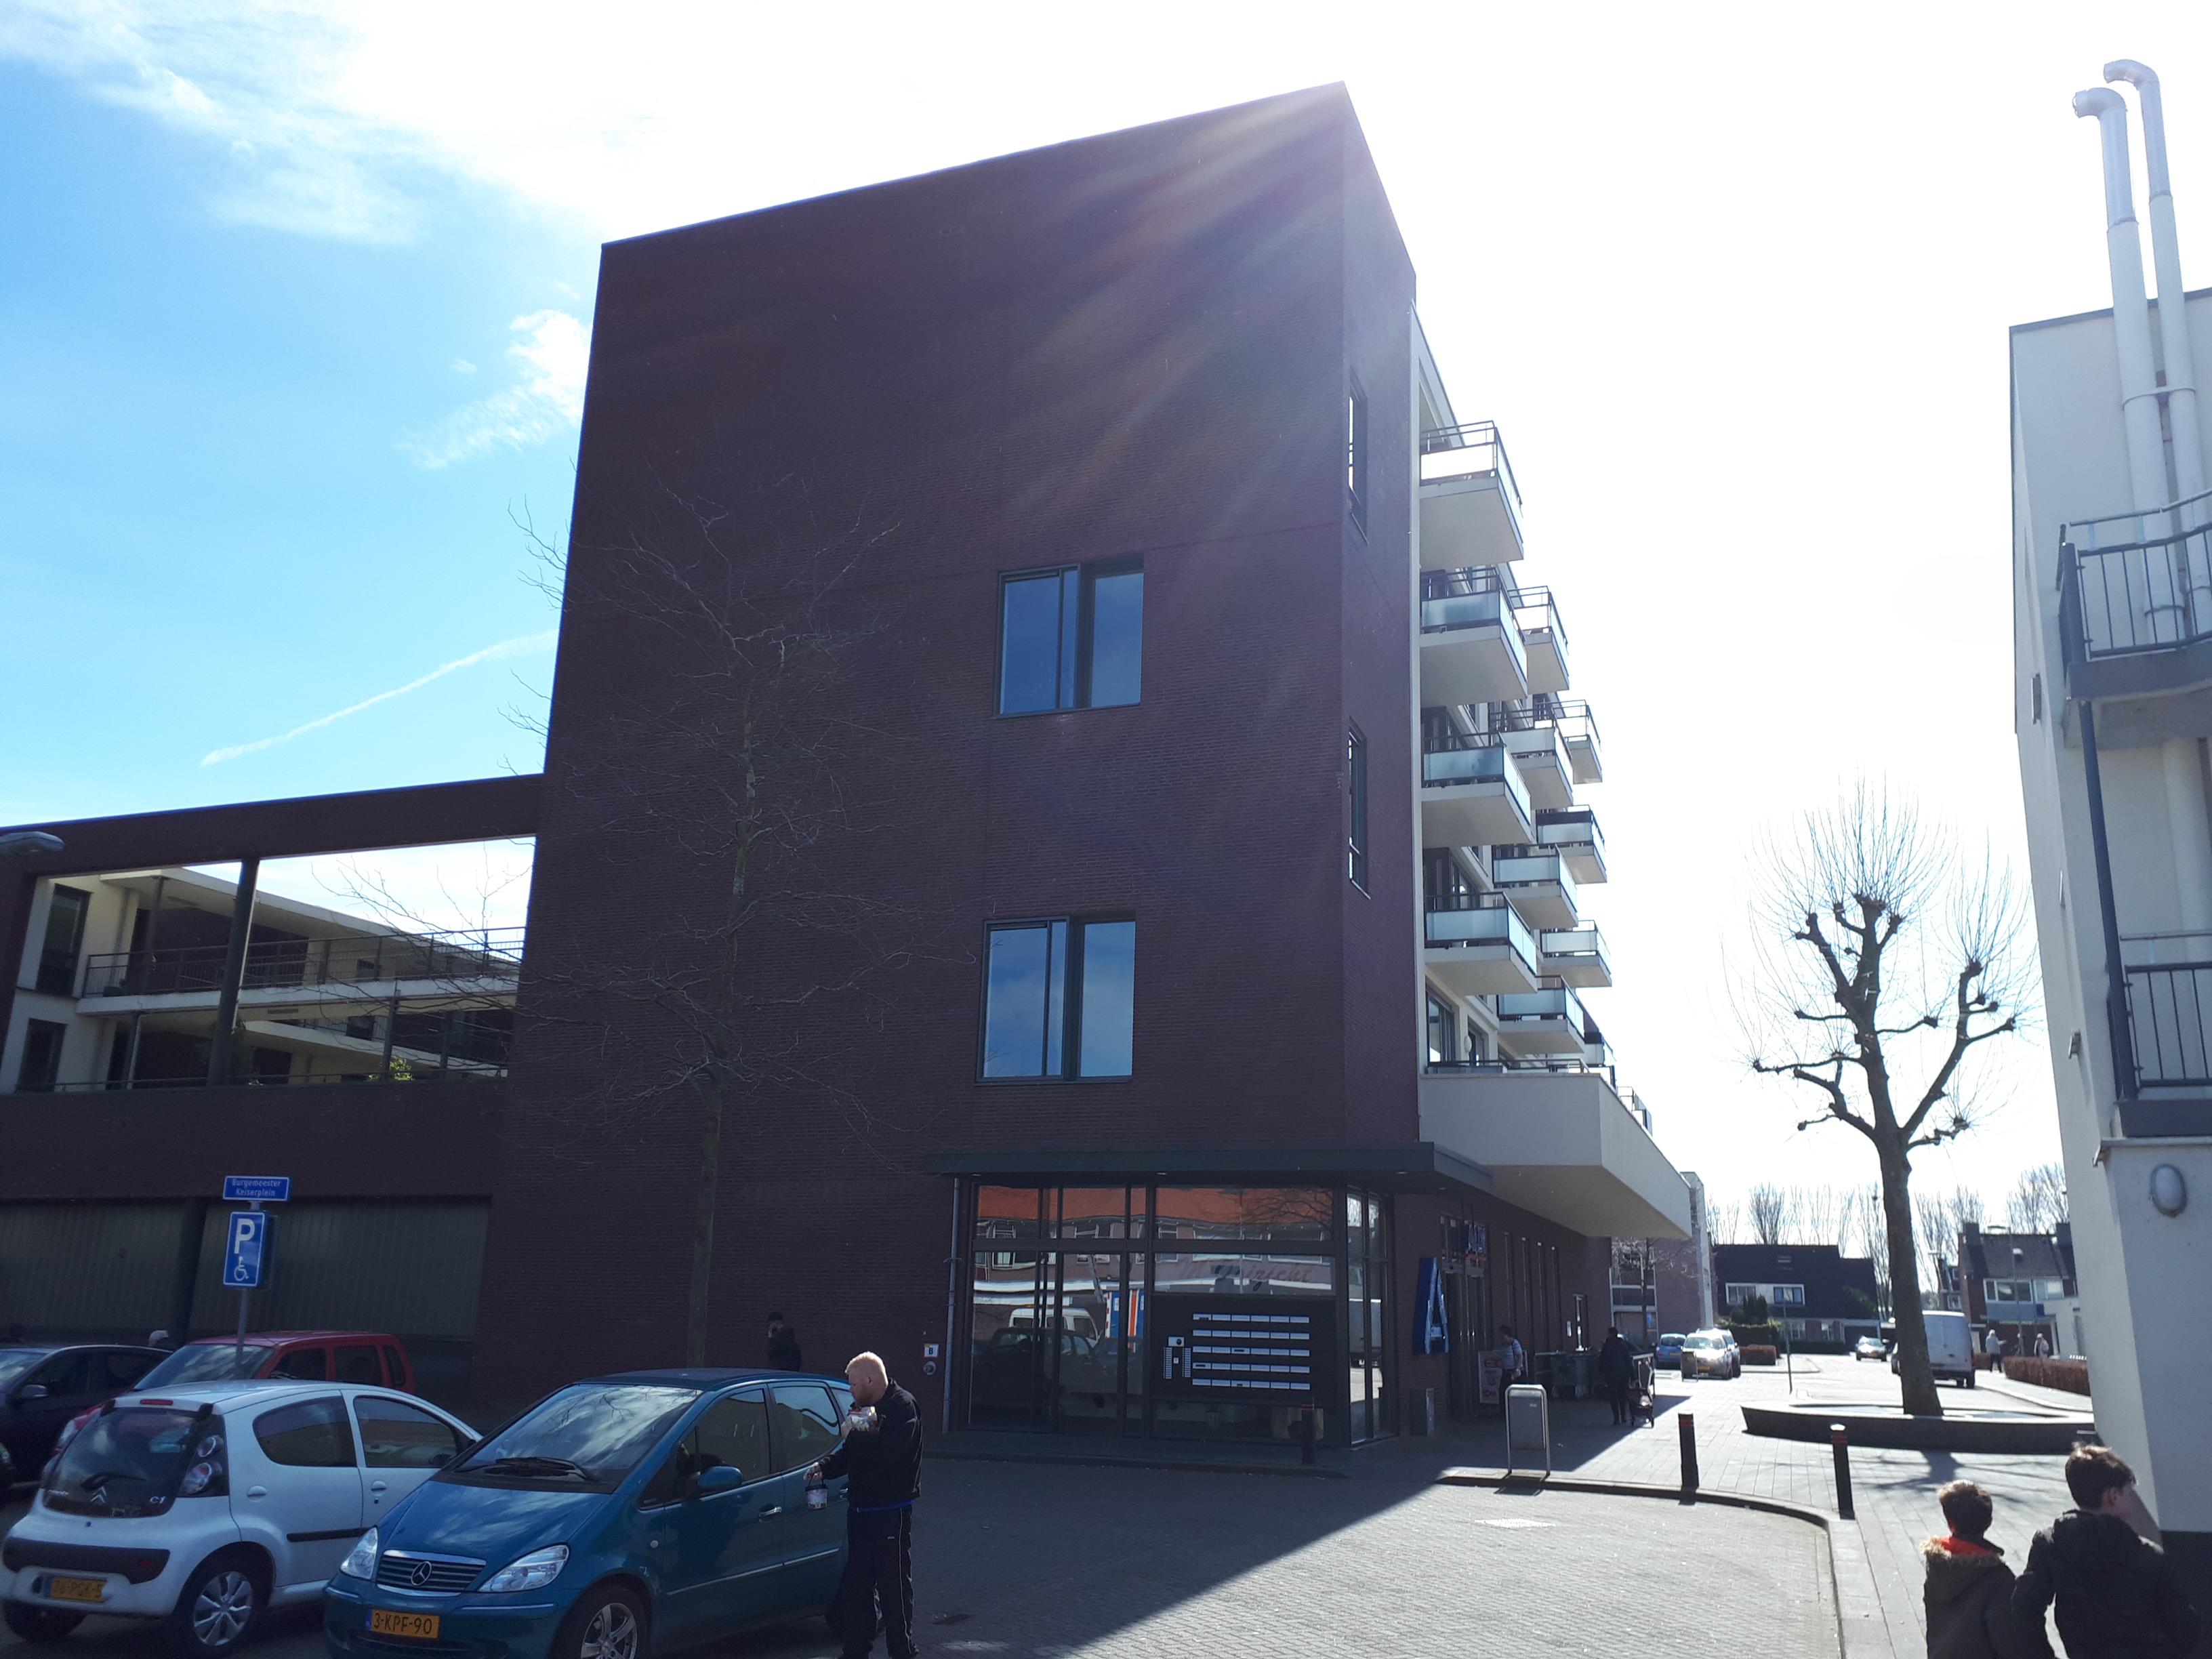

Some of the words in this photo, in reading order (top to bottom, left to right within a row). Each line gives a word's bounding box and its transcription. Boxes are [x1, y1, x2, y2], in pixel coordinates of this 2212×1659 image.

[232, 1178, 281, 1189] Burgemeester
[236, 1189, 276, 1197] Keiserplein
[234, 1218, 255, 1254] P
[149, 1496, 166, 1504] C1
[373, 1613, 432, 1635] 3-KPF-90
